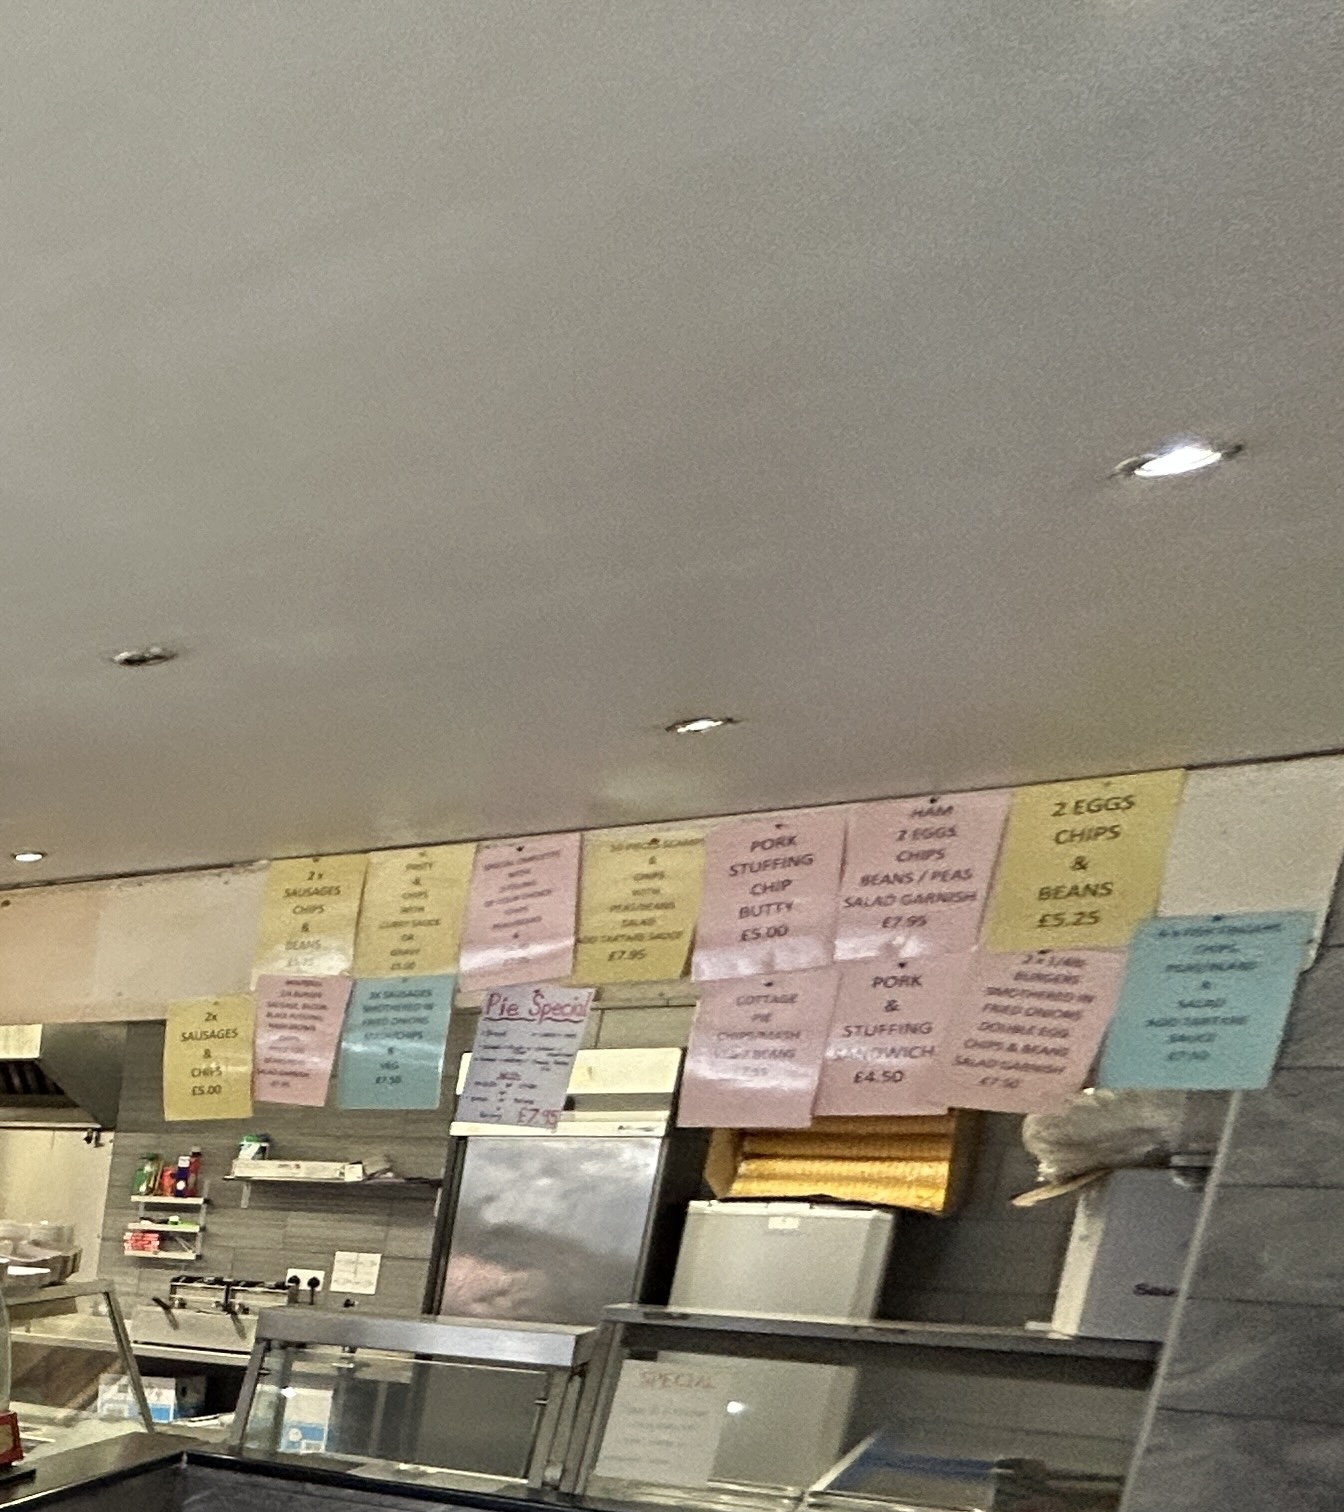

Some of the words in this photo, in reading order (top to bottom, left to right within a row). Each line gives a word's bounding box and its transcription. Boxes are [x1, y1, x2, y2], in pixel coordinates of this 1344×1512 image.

[1052, 802, 1067, 816] 2
[1074, 795, 1135, 815] EGGS
[913, 826, 956, 840] EGGS
[1054, 825, 1121, 845] CHIPS
[751, 835, 797, 852] PORK
[896, 849, 945, 862] CHIPS
[1070, 855, 1088, 870] &
[729, 854, 814, 877] STUFFING
[860, 872, 914, 886] BEANS
[931, 869, 972, 882] PEAS
[283, 885, 341, 898] SAUSAGES
[750, 879, 793, 895] CHIP
[1038, 882, 1113, 901] BEANS
[844, 893, 896, 908] SALAD
[293, 905, 325, 914] CHIPS
[739, 900, 794, 919] BUTTY
[1037, 910, 1100, 928] £5.25
[872, 975, 923, 988] PORK
[485, 991, 519, 1016] Pie
[528, 992, 592, 1024] Special
[884, 999, 900, 1012] &
[181, 1028, 239, 1041] SAUSAGES
[843, 1021, 933, 1038] STUFFING
[203, 1049, 211, 1058] &
[191, 1066, 222, 1077] CHIPS
[191, 1085, 222, 1096] £5.00
